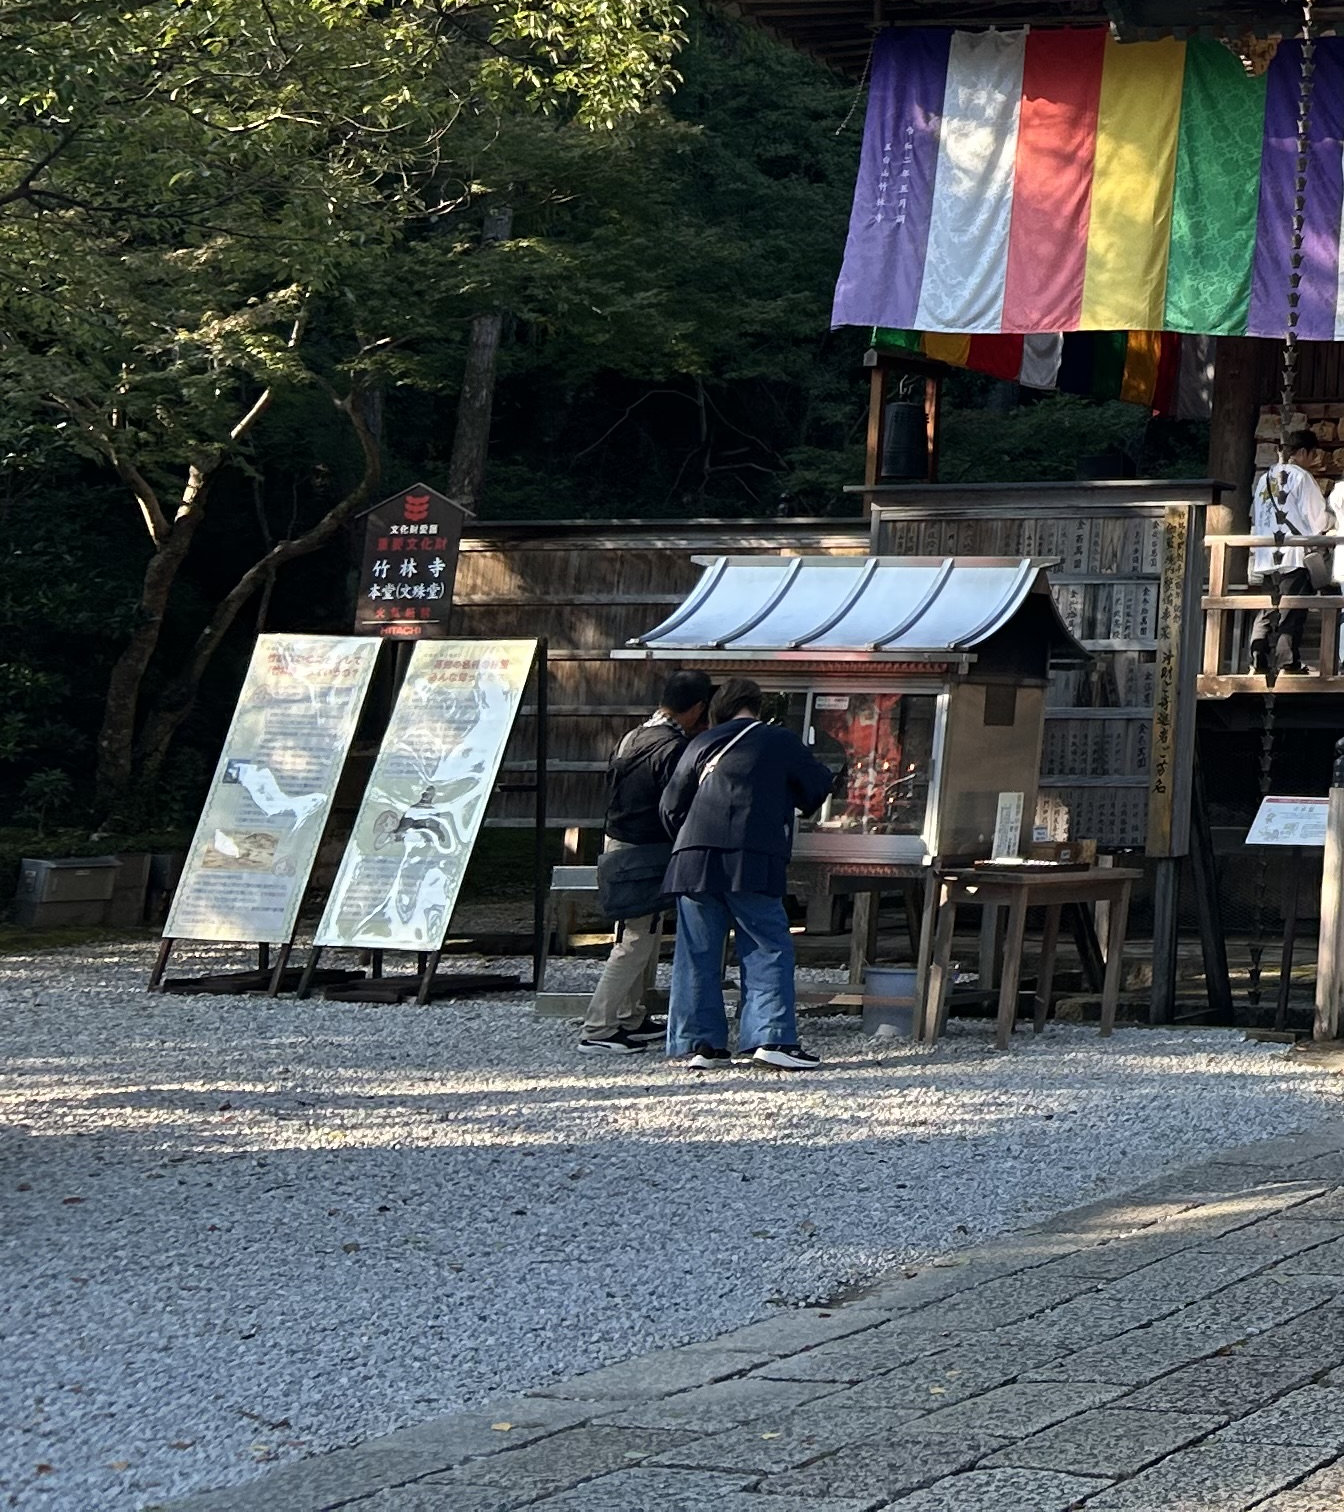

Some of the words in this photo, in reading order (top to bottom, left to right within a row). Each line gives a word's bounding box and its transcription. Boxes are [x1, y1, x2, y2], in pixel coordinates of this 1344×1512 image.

[371, 556, 447, 579] 竹林寺
[380, 625, 422, 636] HITACHI
